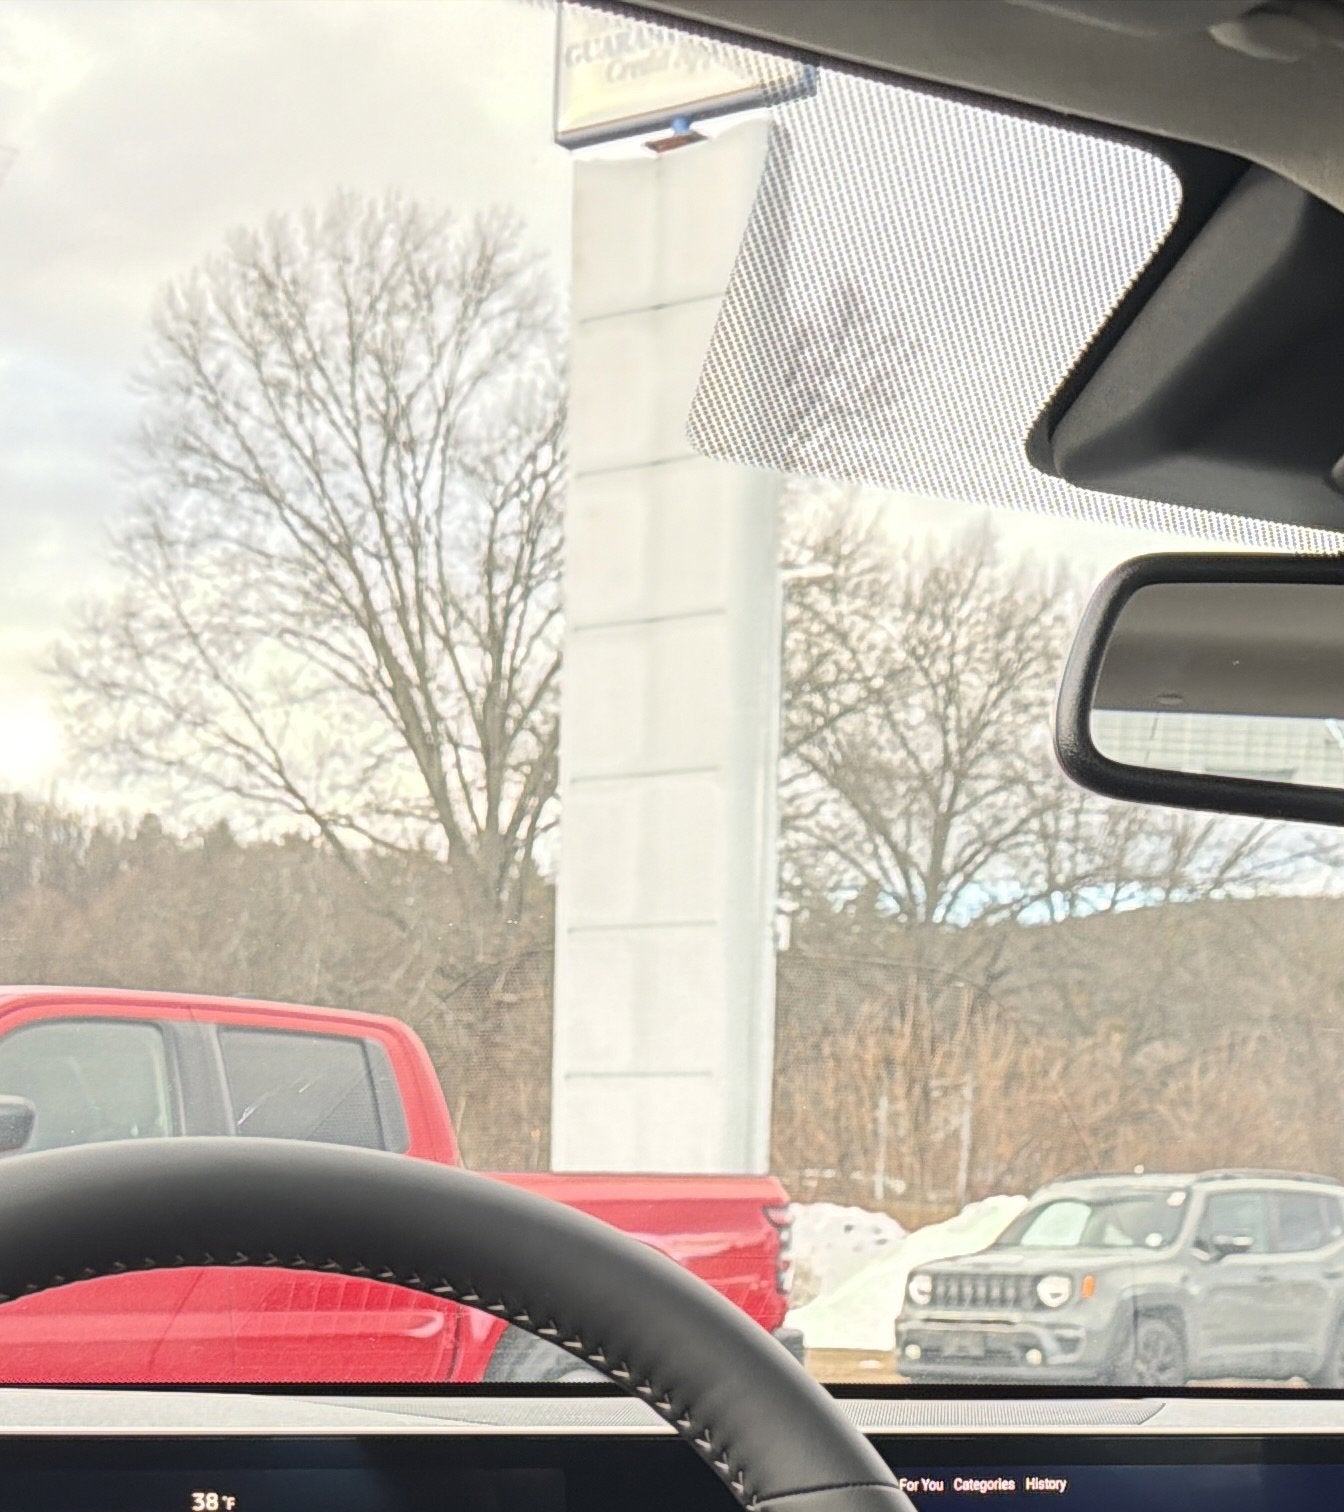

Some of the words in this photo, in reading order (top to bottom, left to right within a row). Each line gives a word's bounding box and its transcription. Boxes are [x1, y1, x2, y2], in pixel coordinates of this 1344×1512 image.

[899, 1478, 919, 1492] For
[920, 1478, 944, 1492] You
[953, 1477, 1016, 1494] Categories
[1025, 1477, 1067, 1494] History
